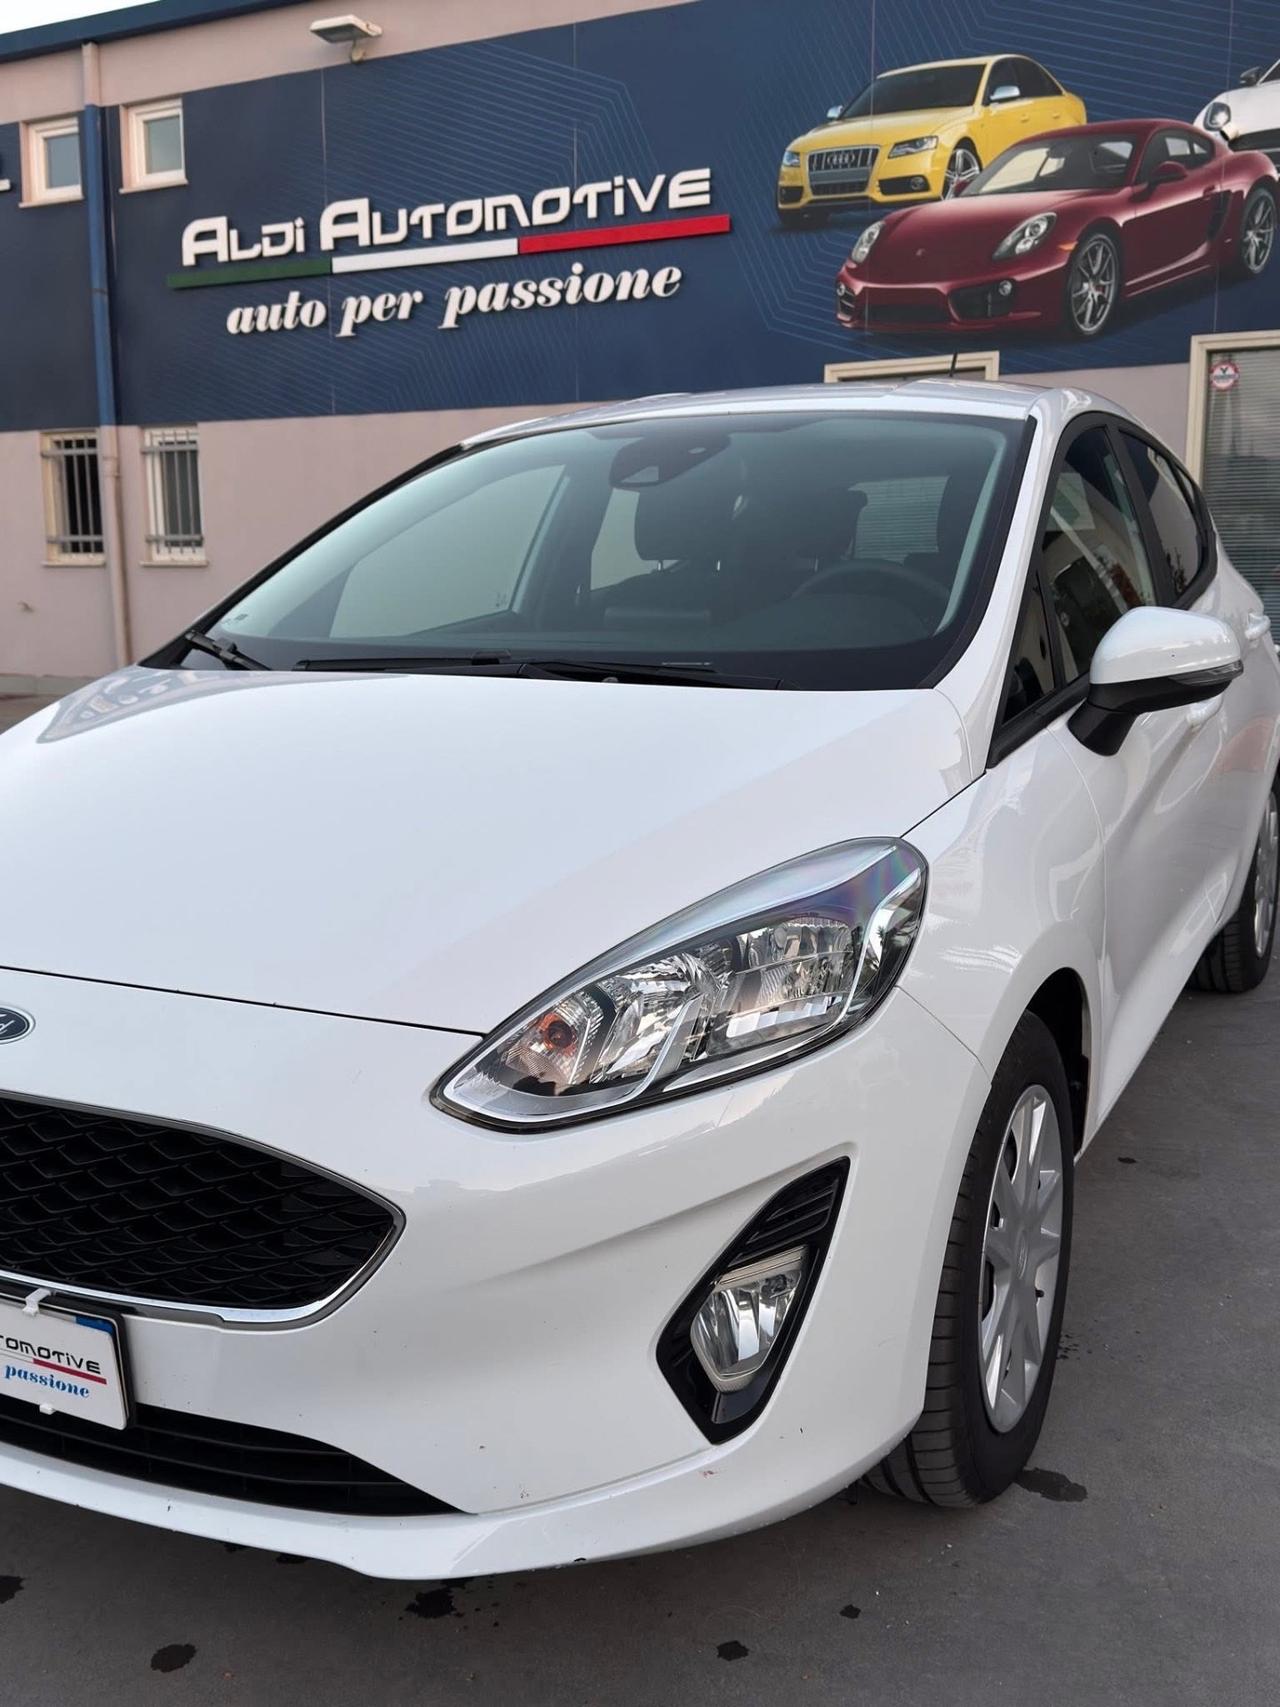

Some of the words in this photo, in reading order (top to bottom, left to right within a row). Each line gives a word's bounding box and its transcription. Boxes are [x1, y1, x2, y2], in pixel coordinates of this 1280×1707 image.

[226, 290, 327, 335] auto
[335, 291, 423, 338] per
[437, 262, 682, 330] passione
[5, 1364, 90, 1398] passione
